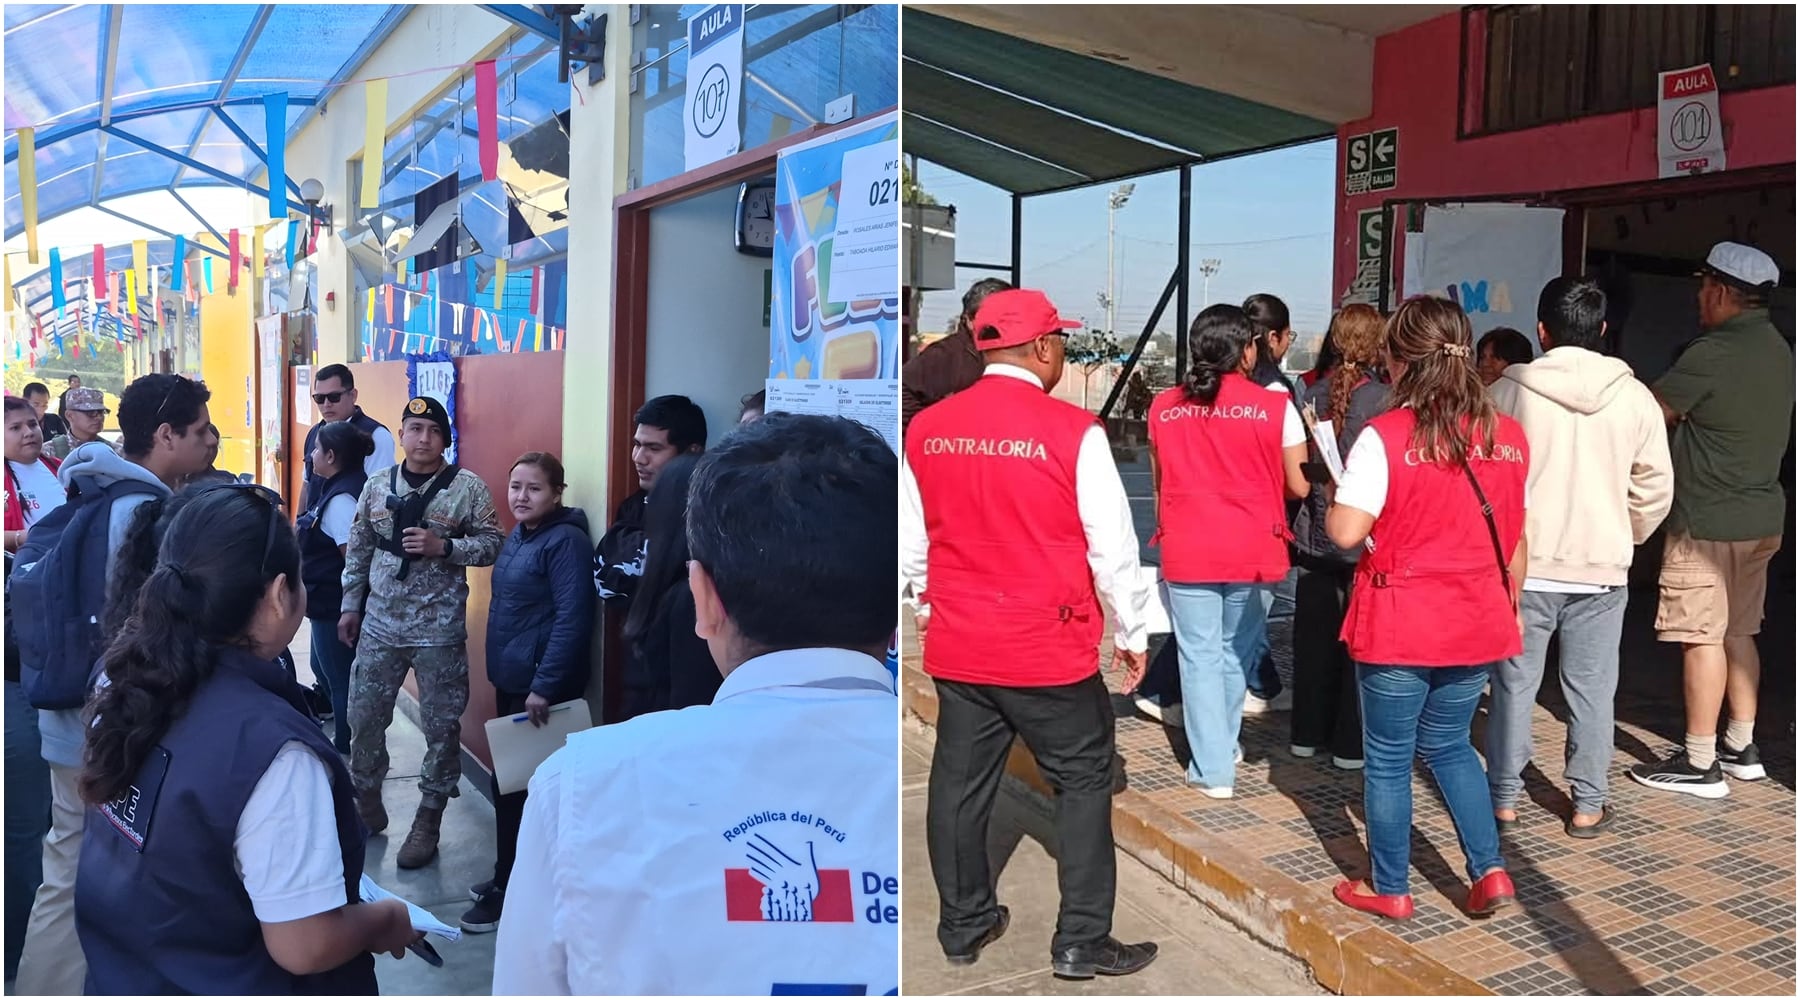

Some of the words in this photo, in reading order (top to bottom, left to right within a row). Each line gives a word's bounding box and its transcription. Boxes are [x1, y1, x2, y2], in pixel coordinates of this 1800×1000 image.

[699, 5, 732, 41] AULA
[1674, 74, 1709, 92] AULA
[698, 78, 725, 124] 107
[1674, 108, 1706, 143] 101
[1350, 140, 1367, 170] S
[869, 178, 898, 207] 021
[1372, 173, 1394, 186] SALIDA
[419, 369, 450, 396] ELIGE
[1160, 404, 1268, 422] CONTRALORÍA
[924, 437, 1047, 461] CONTRALORÍA
[1404, 443, 1524, 466] CONAORÍA
[723, 811, 787, 842] República
[791, 811, 812, 825] del
[815, 818, 846, 843] Perú
[862, 872, 898, 895] De
[865, 898, 898, 924] de
